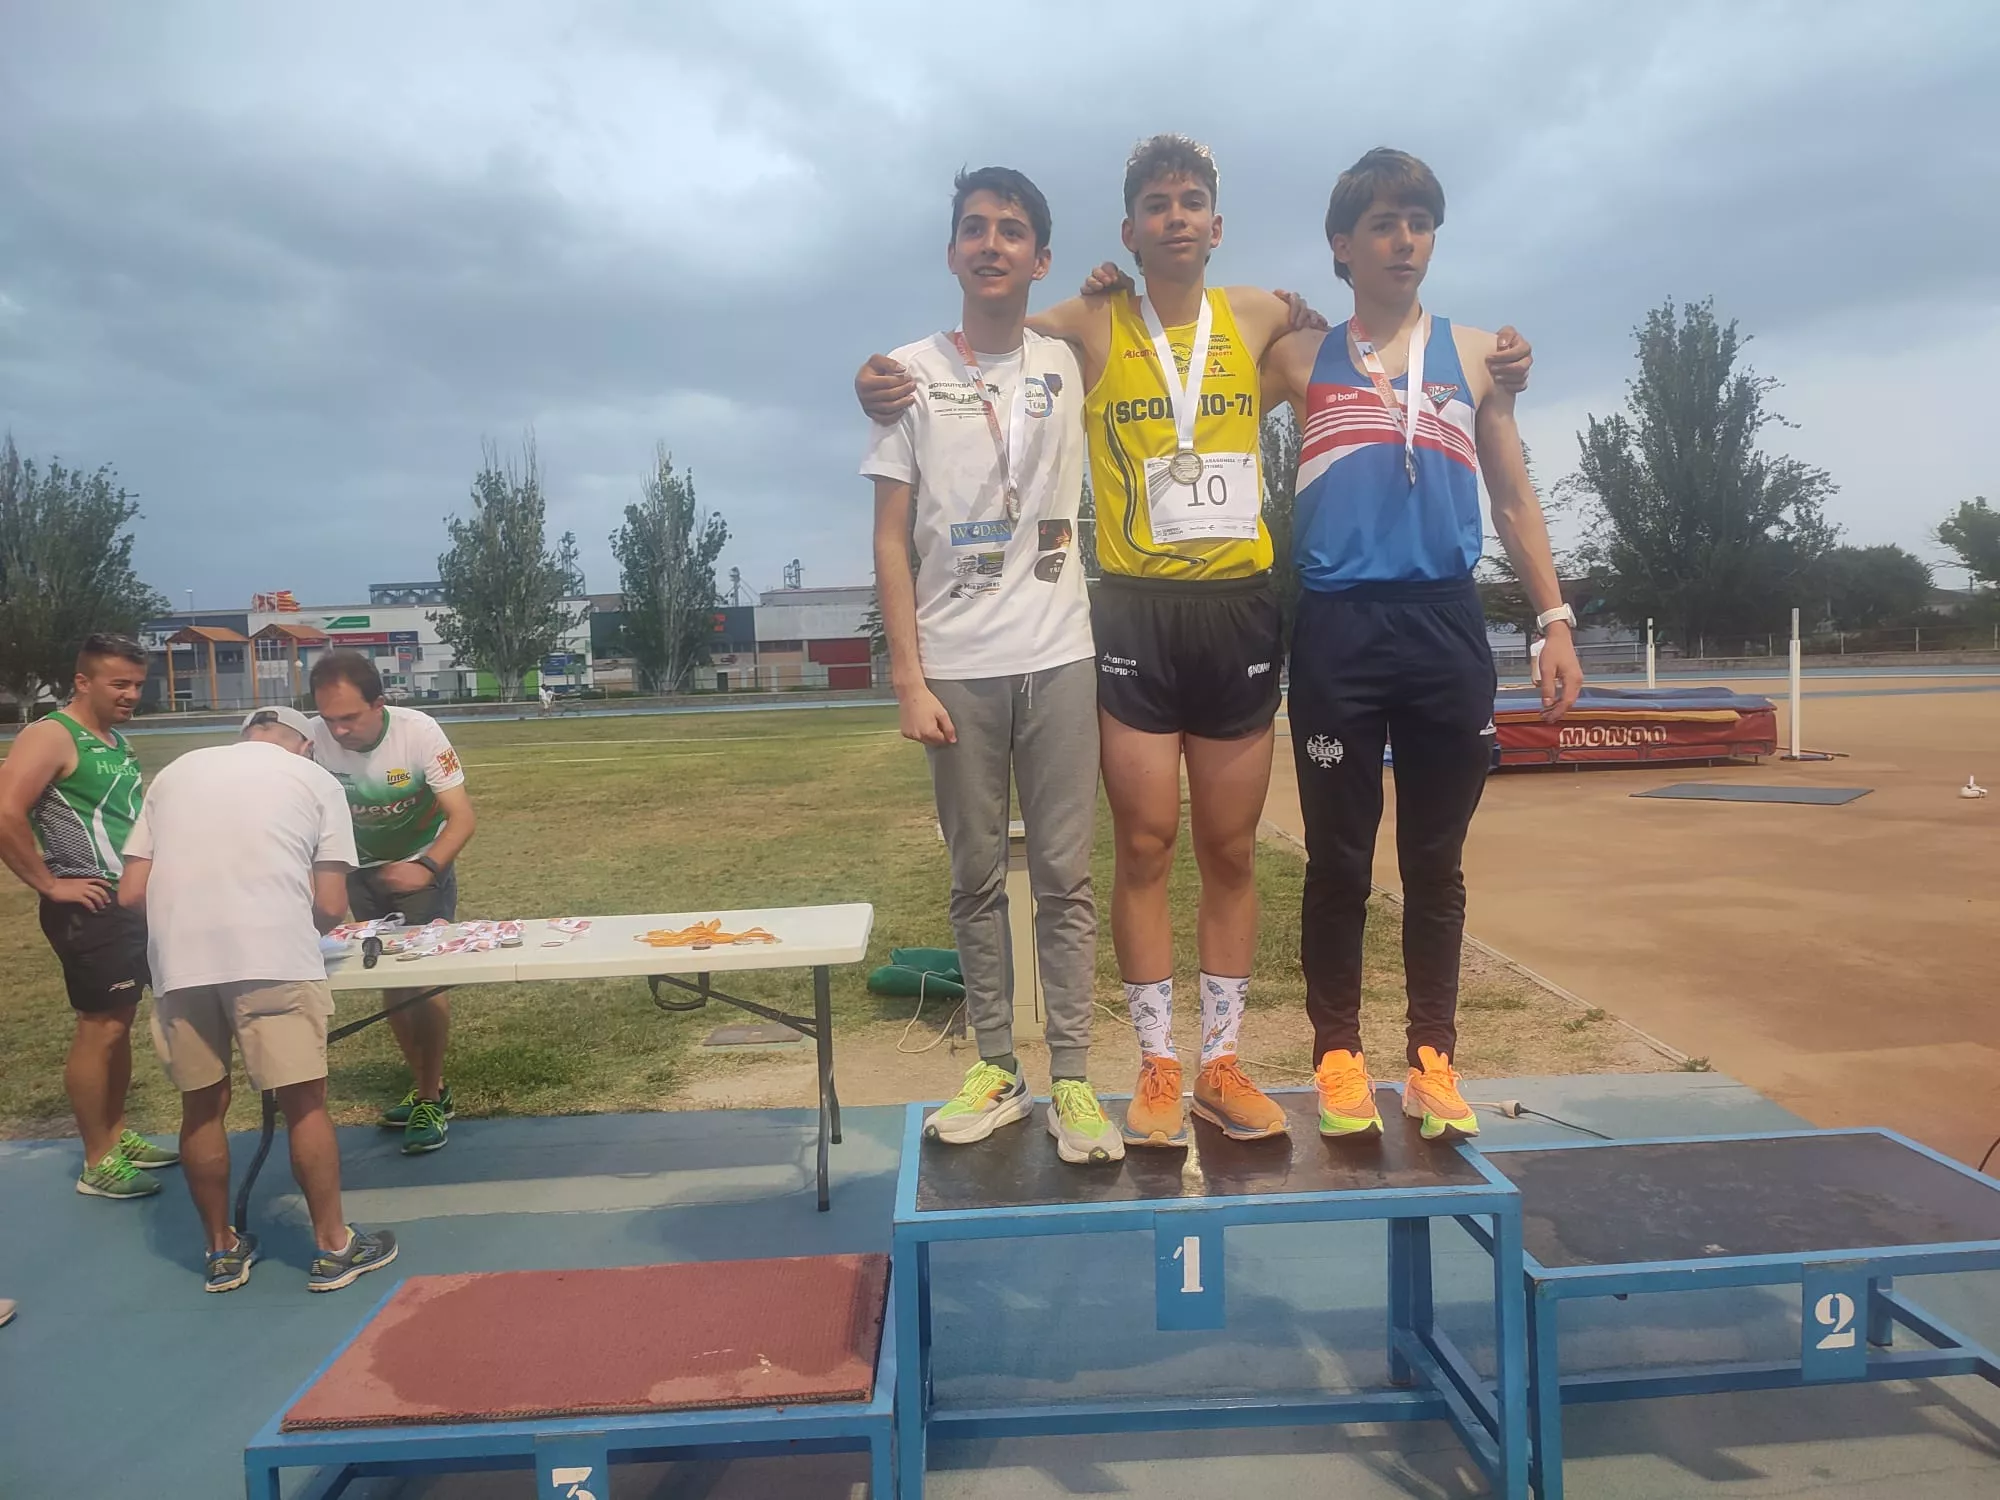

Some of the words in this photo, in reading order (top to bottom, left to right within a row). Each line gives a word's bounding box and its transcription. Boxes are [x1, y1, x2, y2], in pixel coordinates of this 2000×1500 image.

[1116, 393, 1253, 424] SCOIO-71
[1187, 474, 1228, 507] 10
[1559, 726, 1667, 748] MONDO
[350, 797, 417, 815] uesca
[1173, 1236, 1204, 1293] 1
[1815, 1292, 1856, 1350] 2
[551, 1466, 597, 1500] 3
